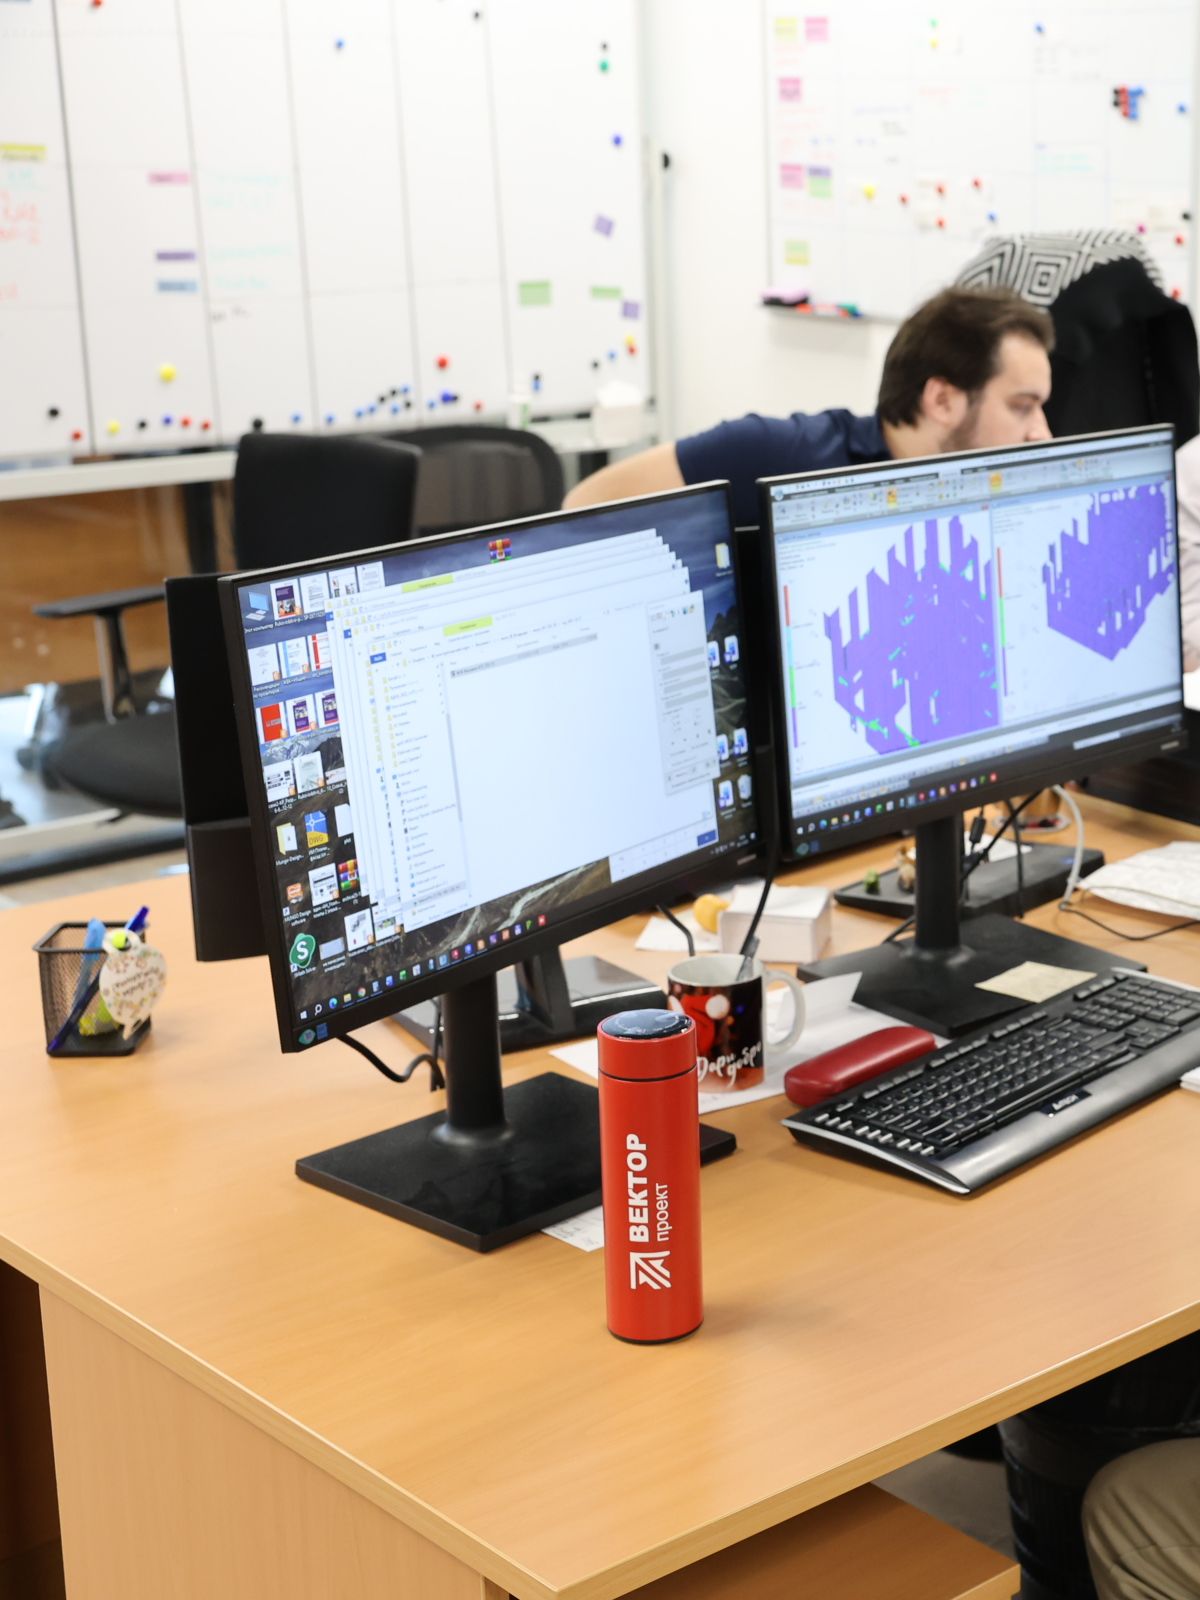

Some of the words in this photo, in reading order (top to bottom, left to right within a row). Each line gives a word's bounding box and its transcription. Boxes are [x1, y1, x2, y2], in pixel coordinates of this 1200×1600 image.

[296, 941, 309, 960] S
[626, 1133, 649, 1243] ВЕКТОР
[656, 1183, 672, 1242] проект
